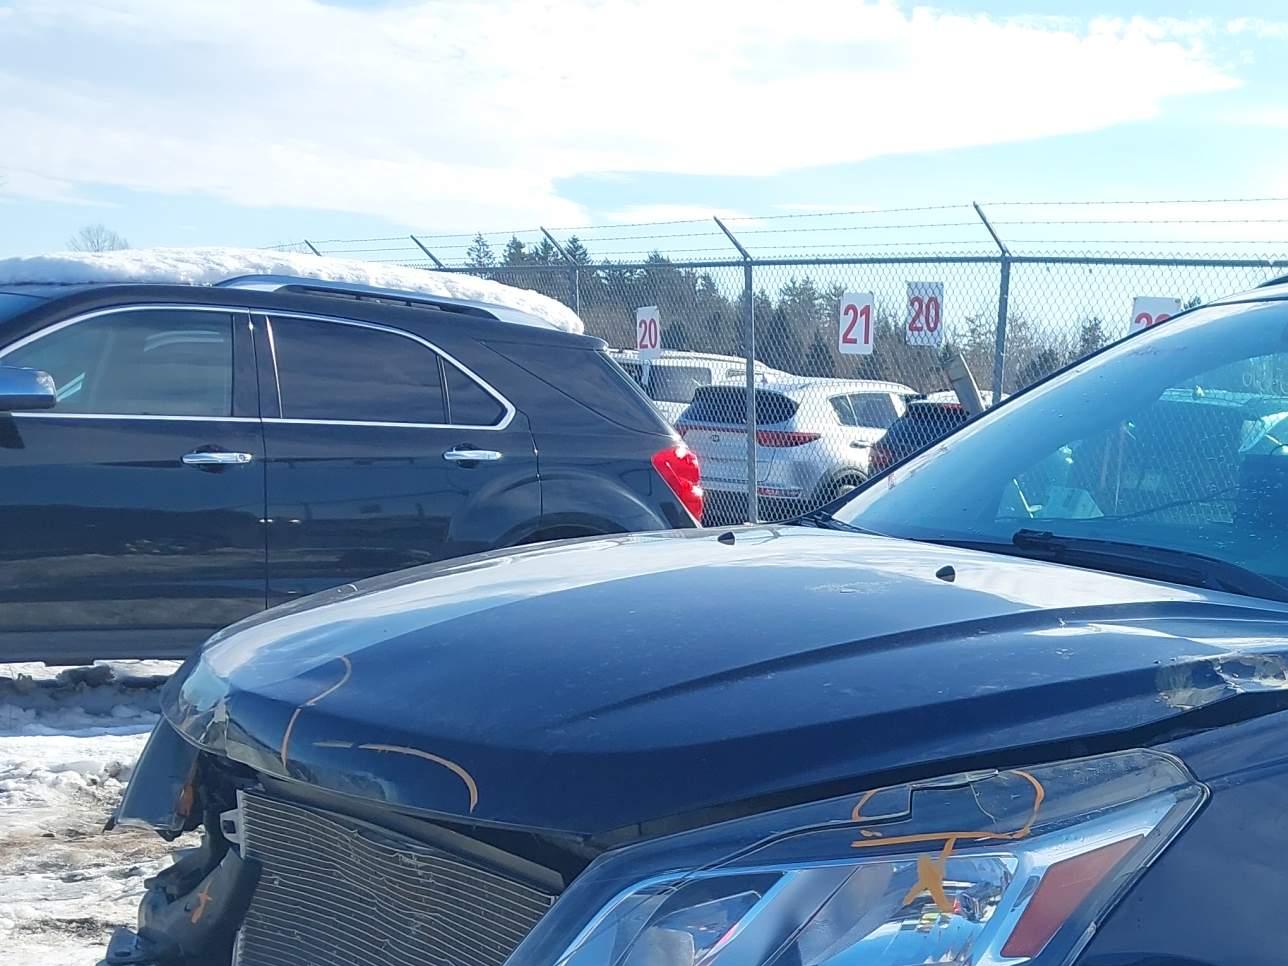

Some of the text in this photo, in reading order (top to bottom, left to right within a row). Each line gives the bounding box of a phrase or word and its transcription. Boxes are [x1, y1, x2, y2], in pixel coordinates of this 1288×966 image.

[841, 303, 871, 345] 21
[907, 296, 940, 333] 20
[638, 318, 657, 350] 20
